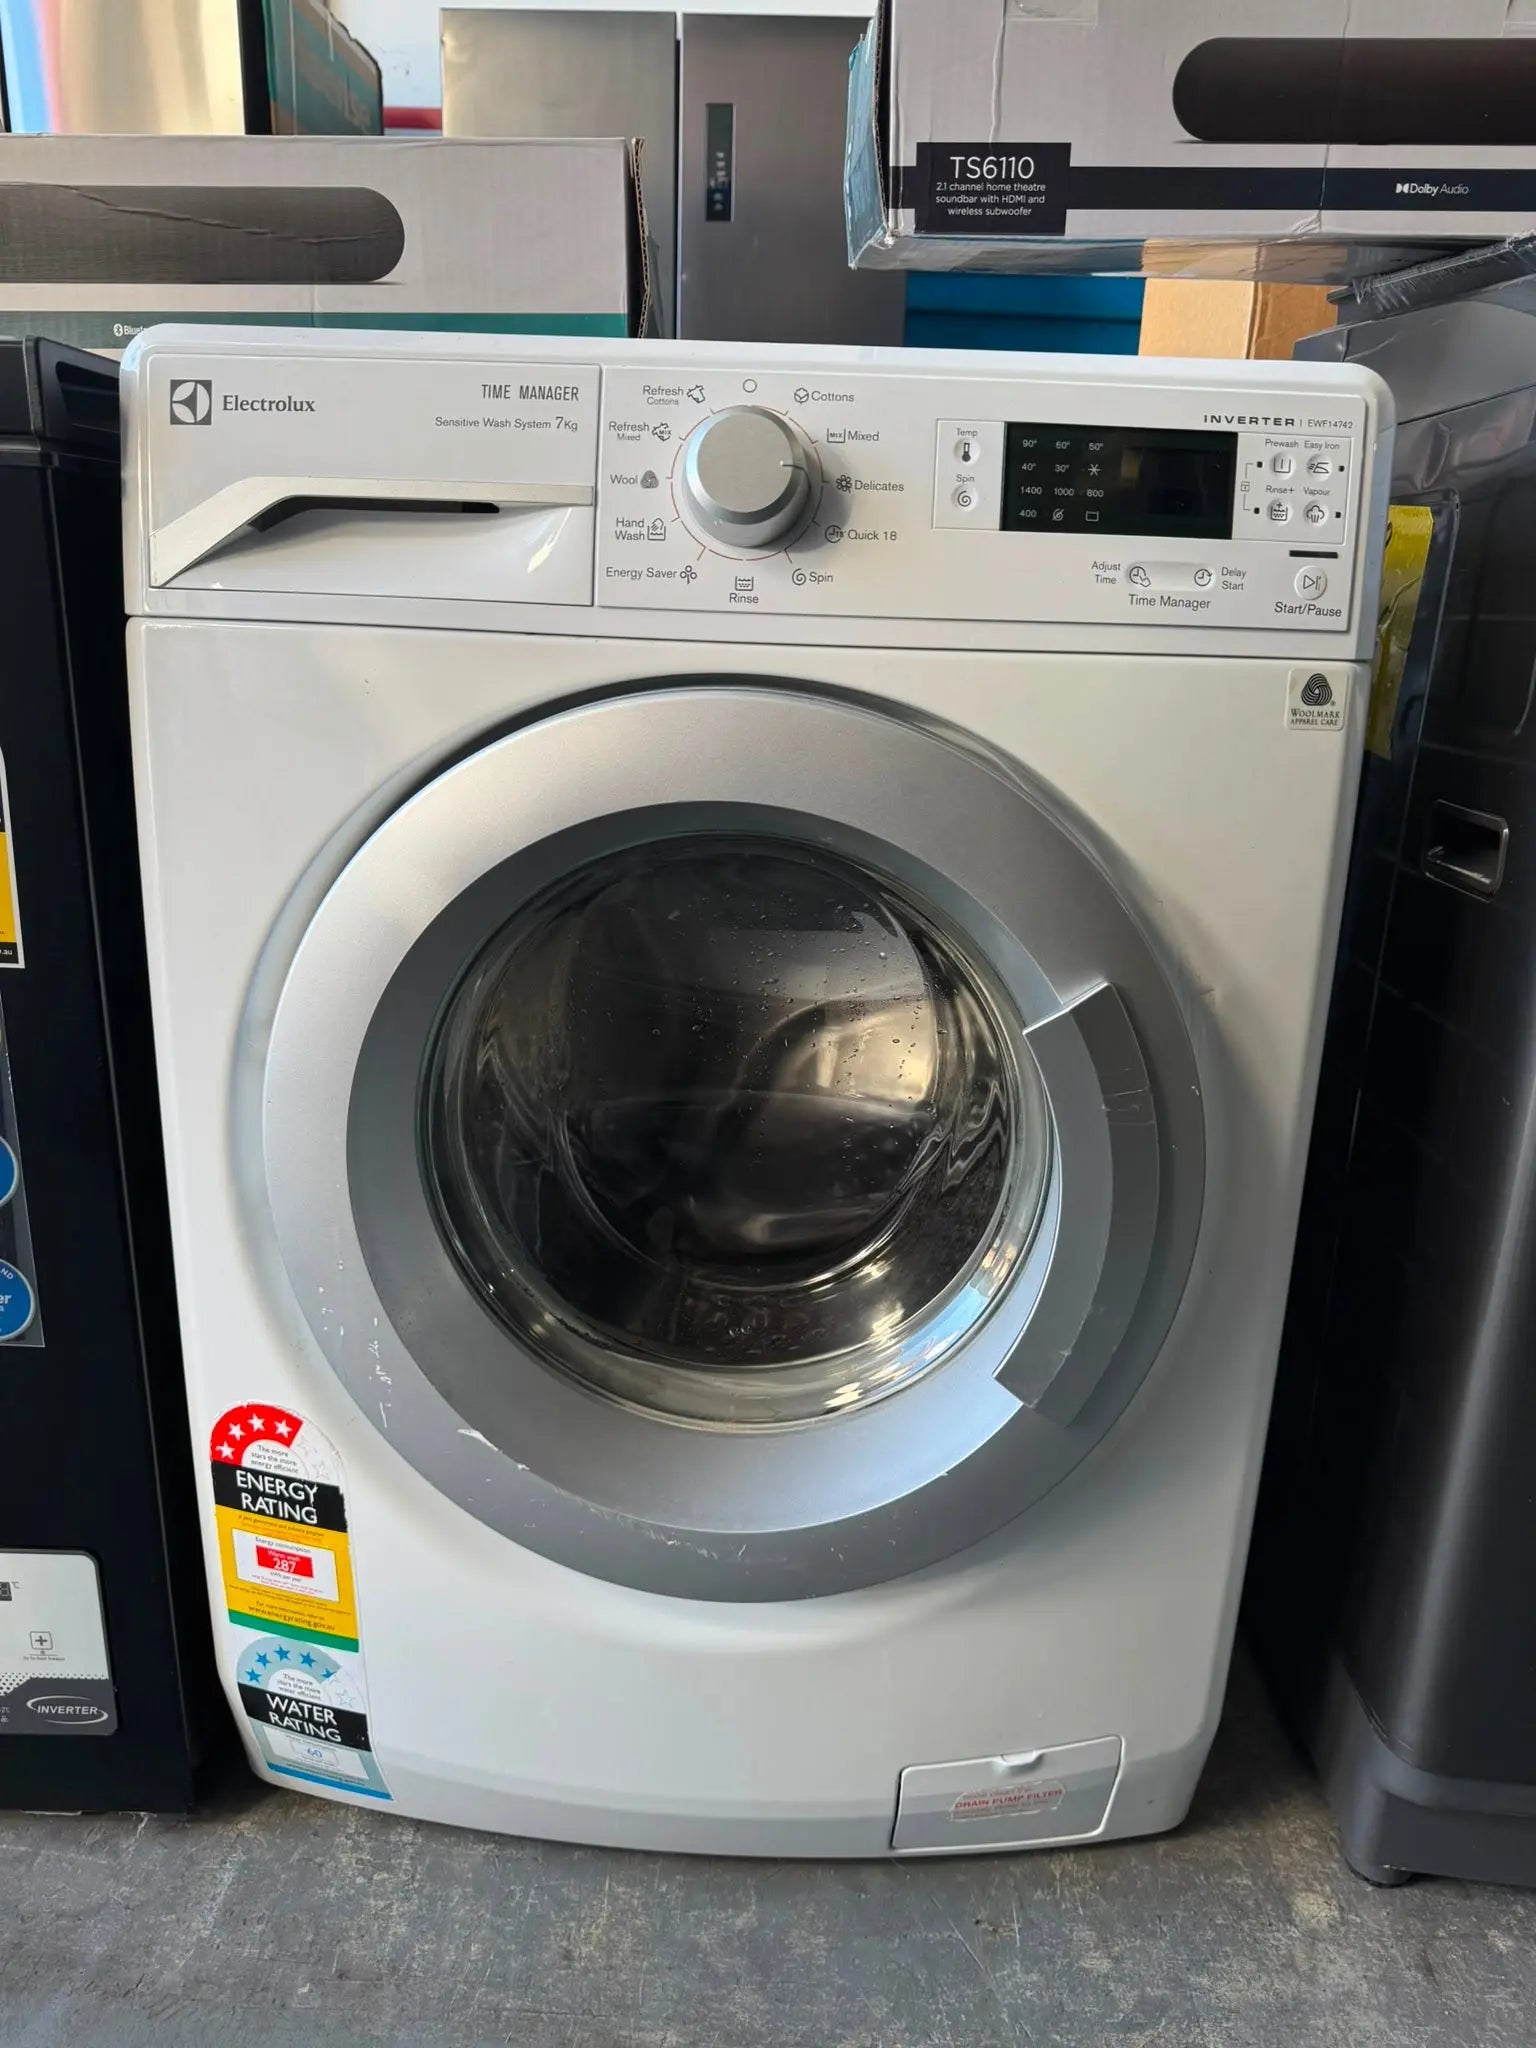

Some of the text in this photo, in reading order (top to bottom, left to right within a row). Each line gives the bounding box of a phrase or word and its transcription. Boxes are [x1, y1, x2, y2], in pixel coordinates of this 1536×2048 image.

[950, 156, 1035, 180] TS6110
[936, 182, 1046, 192] 2.1 channel home theatre
[1410, 183, 1470, 196] Dolby Audio
[936, 194, 1046, 204] soundbar with HDMI and
[948, 206, 1032, 216] wireless subwoofer
[481, 384, 580, 401] TIME MANAGER
[642, 385, 684, 396] Refresh
[811, 390, 855, 402] Cottons
[222, 394, 316, 412] Electrolux
[646, 396, 680, 406] Cottons
[434, 416, 480, 428] Sensitive
[482, 418, 511, 428] Wash
[514, 418, 552, 431] System
[608, 420, 650, 432] Refresh
[1204, 414, 1354, 429] INVERTER EWF14742
[617, 433, 641, 441] Mixed
[848, 430, 880, 442] Mixed
[956, 428, 978, 437] Temp
[1264, 438, 1299, 449] Prewash
[1304, 440, 1340, 451] Easy Iron
[610, 474, 638, 485] Wool
[956, 474, 975, 484] Spin
[854, 480, 905, 492] Delicates
[1020, 486, 1043, 495] 1400
[1054, 488, 1075, 496] 1000
[1266, 484, 1295, 494] Rinse+
[1304, 486, 1331, 498] Vapour
[1019, 509, 1038, 518] 400
[616, 517, 645, 528] Hand
[614, 530, 646, 541] Wash
[848, 528, 898, 541] Quick 18
[606, 566, 678, 580] Energy Saver
[1091, 561, 1121, 573] Adjust
[1221, 566, 1247, 579] Delay
[808, 571, 834, 584] Spin
[1095, 574, 1117, 585] Time
[1222, 581, 1244, 591] Start
[729, 592, 759, 604] Rinse
[1128, 594, 1211, 612] Time Manager
[1274, 601, 1342, 618] Start/Pause
[1290, 718, 1339, 726] APPAREL CARE
[257, 1444, 289, 1458] The more
[251, 1452, 266, 1460] stars
[280, 1458, 298, 1466] more
[236, 1470, 318, 1504] ENERGY
[241, 1492, 318, 1524] RATING
[272, 1558, 297, 1574] 287
[37, 1706, 98, 1715] INVERTER
[266, 1694, 338, 1726] WATER
[268, 1712, 342, 1742] RATING
[955, 1800, 990, 1808] DRAIN
[992, 1796, 1024, 1804] PUMP
[1026, 1788, 1063, 1800] FILTER
